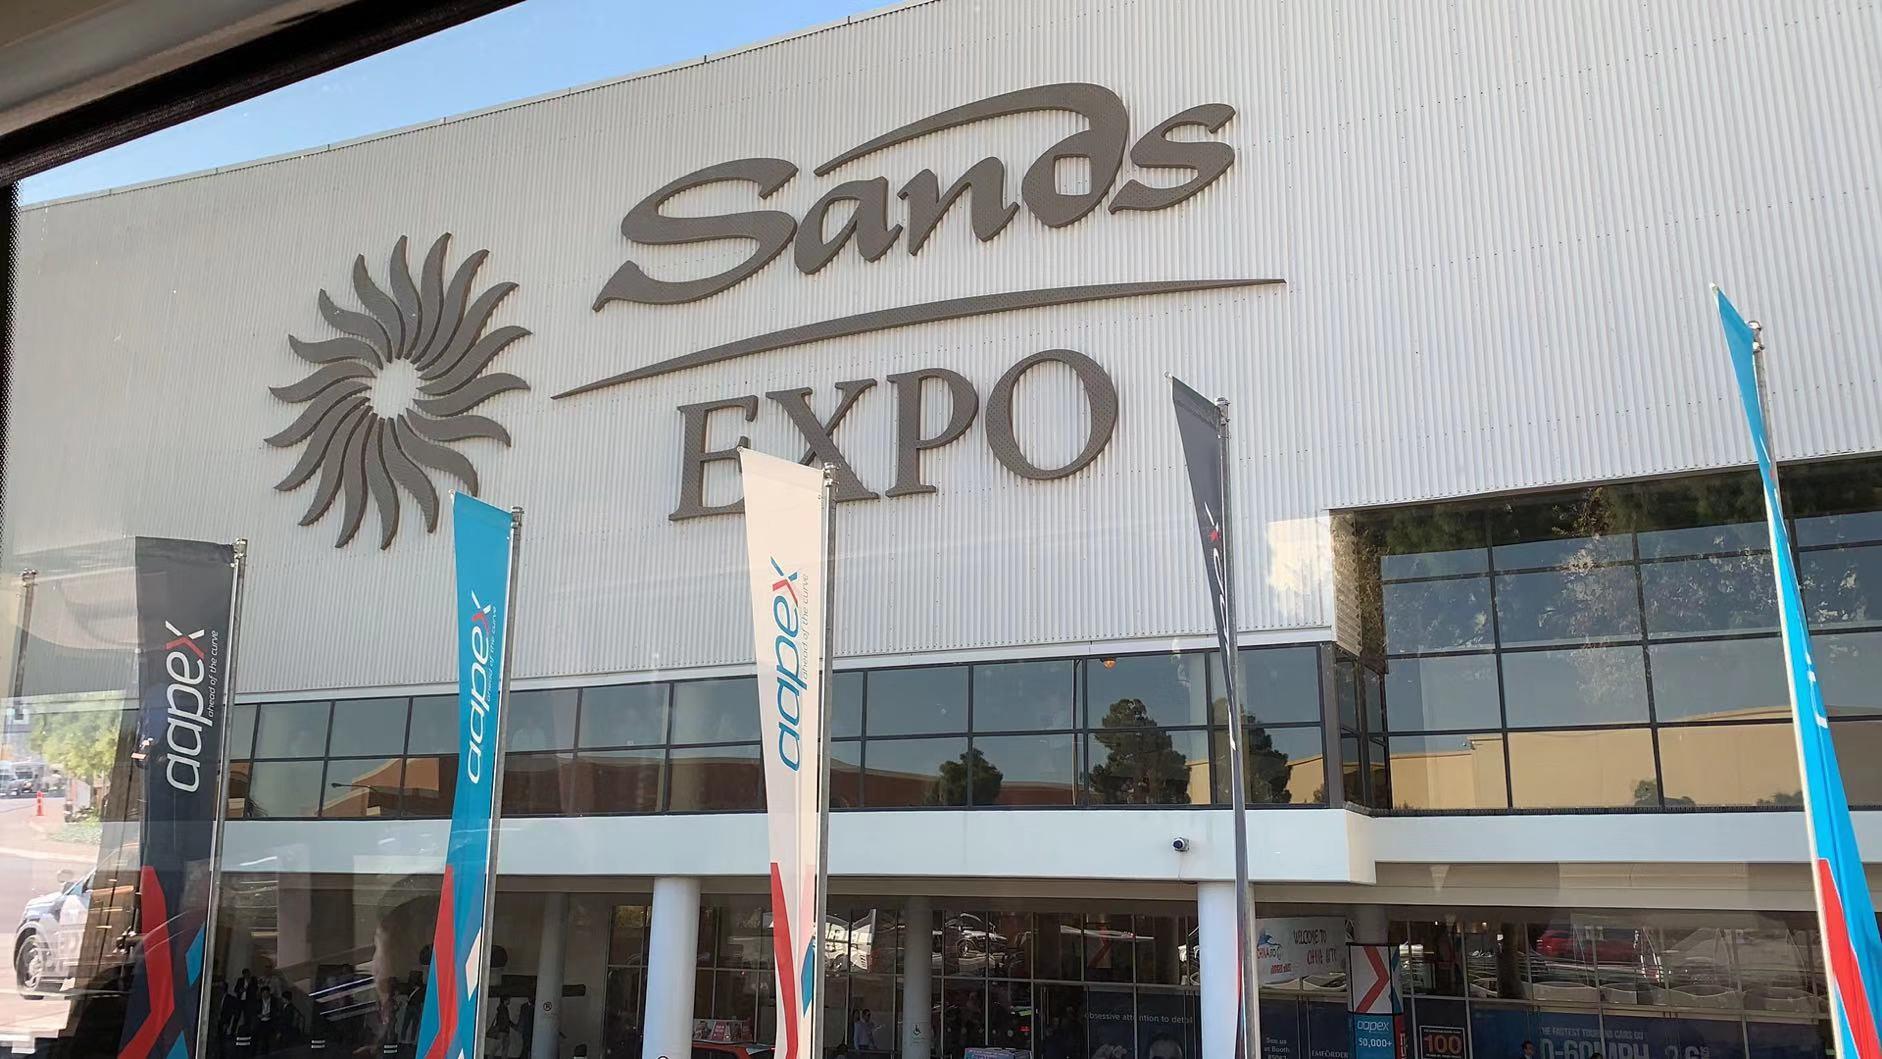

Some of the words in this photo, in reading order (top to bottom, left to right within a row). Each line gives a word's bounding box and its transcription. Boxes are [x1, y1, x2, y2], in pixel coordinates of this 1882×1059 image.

[592, 82, 1237, 312] Sands
[668, 348, 1119, 521] EXPO
[801, 606, 809, 626] the
[211, 630, 219, 656] curve
[801, 627, 810, 641] of
[209, 657, 218, 673] the
[770, 556, 808, 772] aapex
[208, 674, 218, 686] of
[468, 590, 492, 785] aapex
[164, 620, 213, 793] aapex
[207, 686, 216, 718] ahead
[1161, 1014, 1170, 1022] to
[1357, 1020, 1389, 1033] aapex
[1359, 1038, 1392, 1048] 50,000+
[1424, 1034, 1462, 1054] 100
